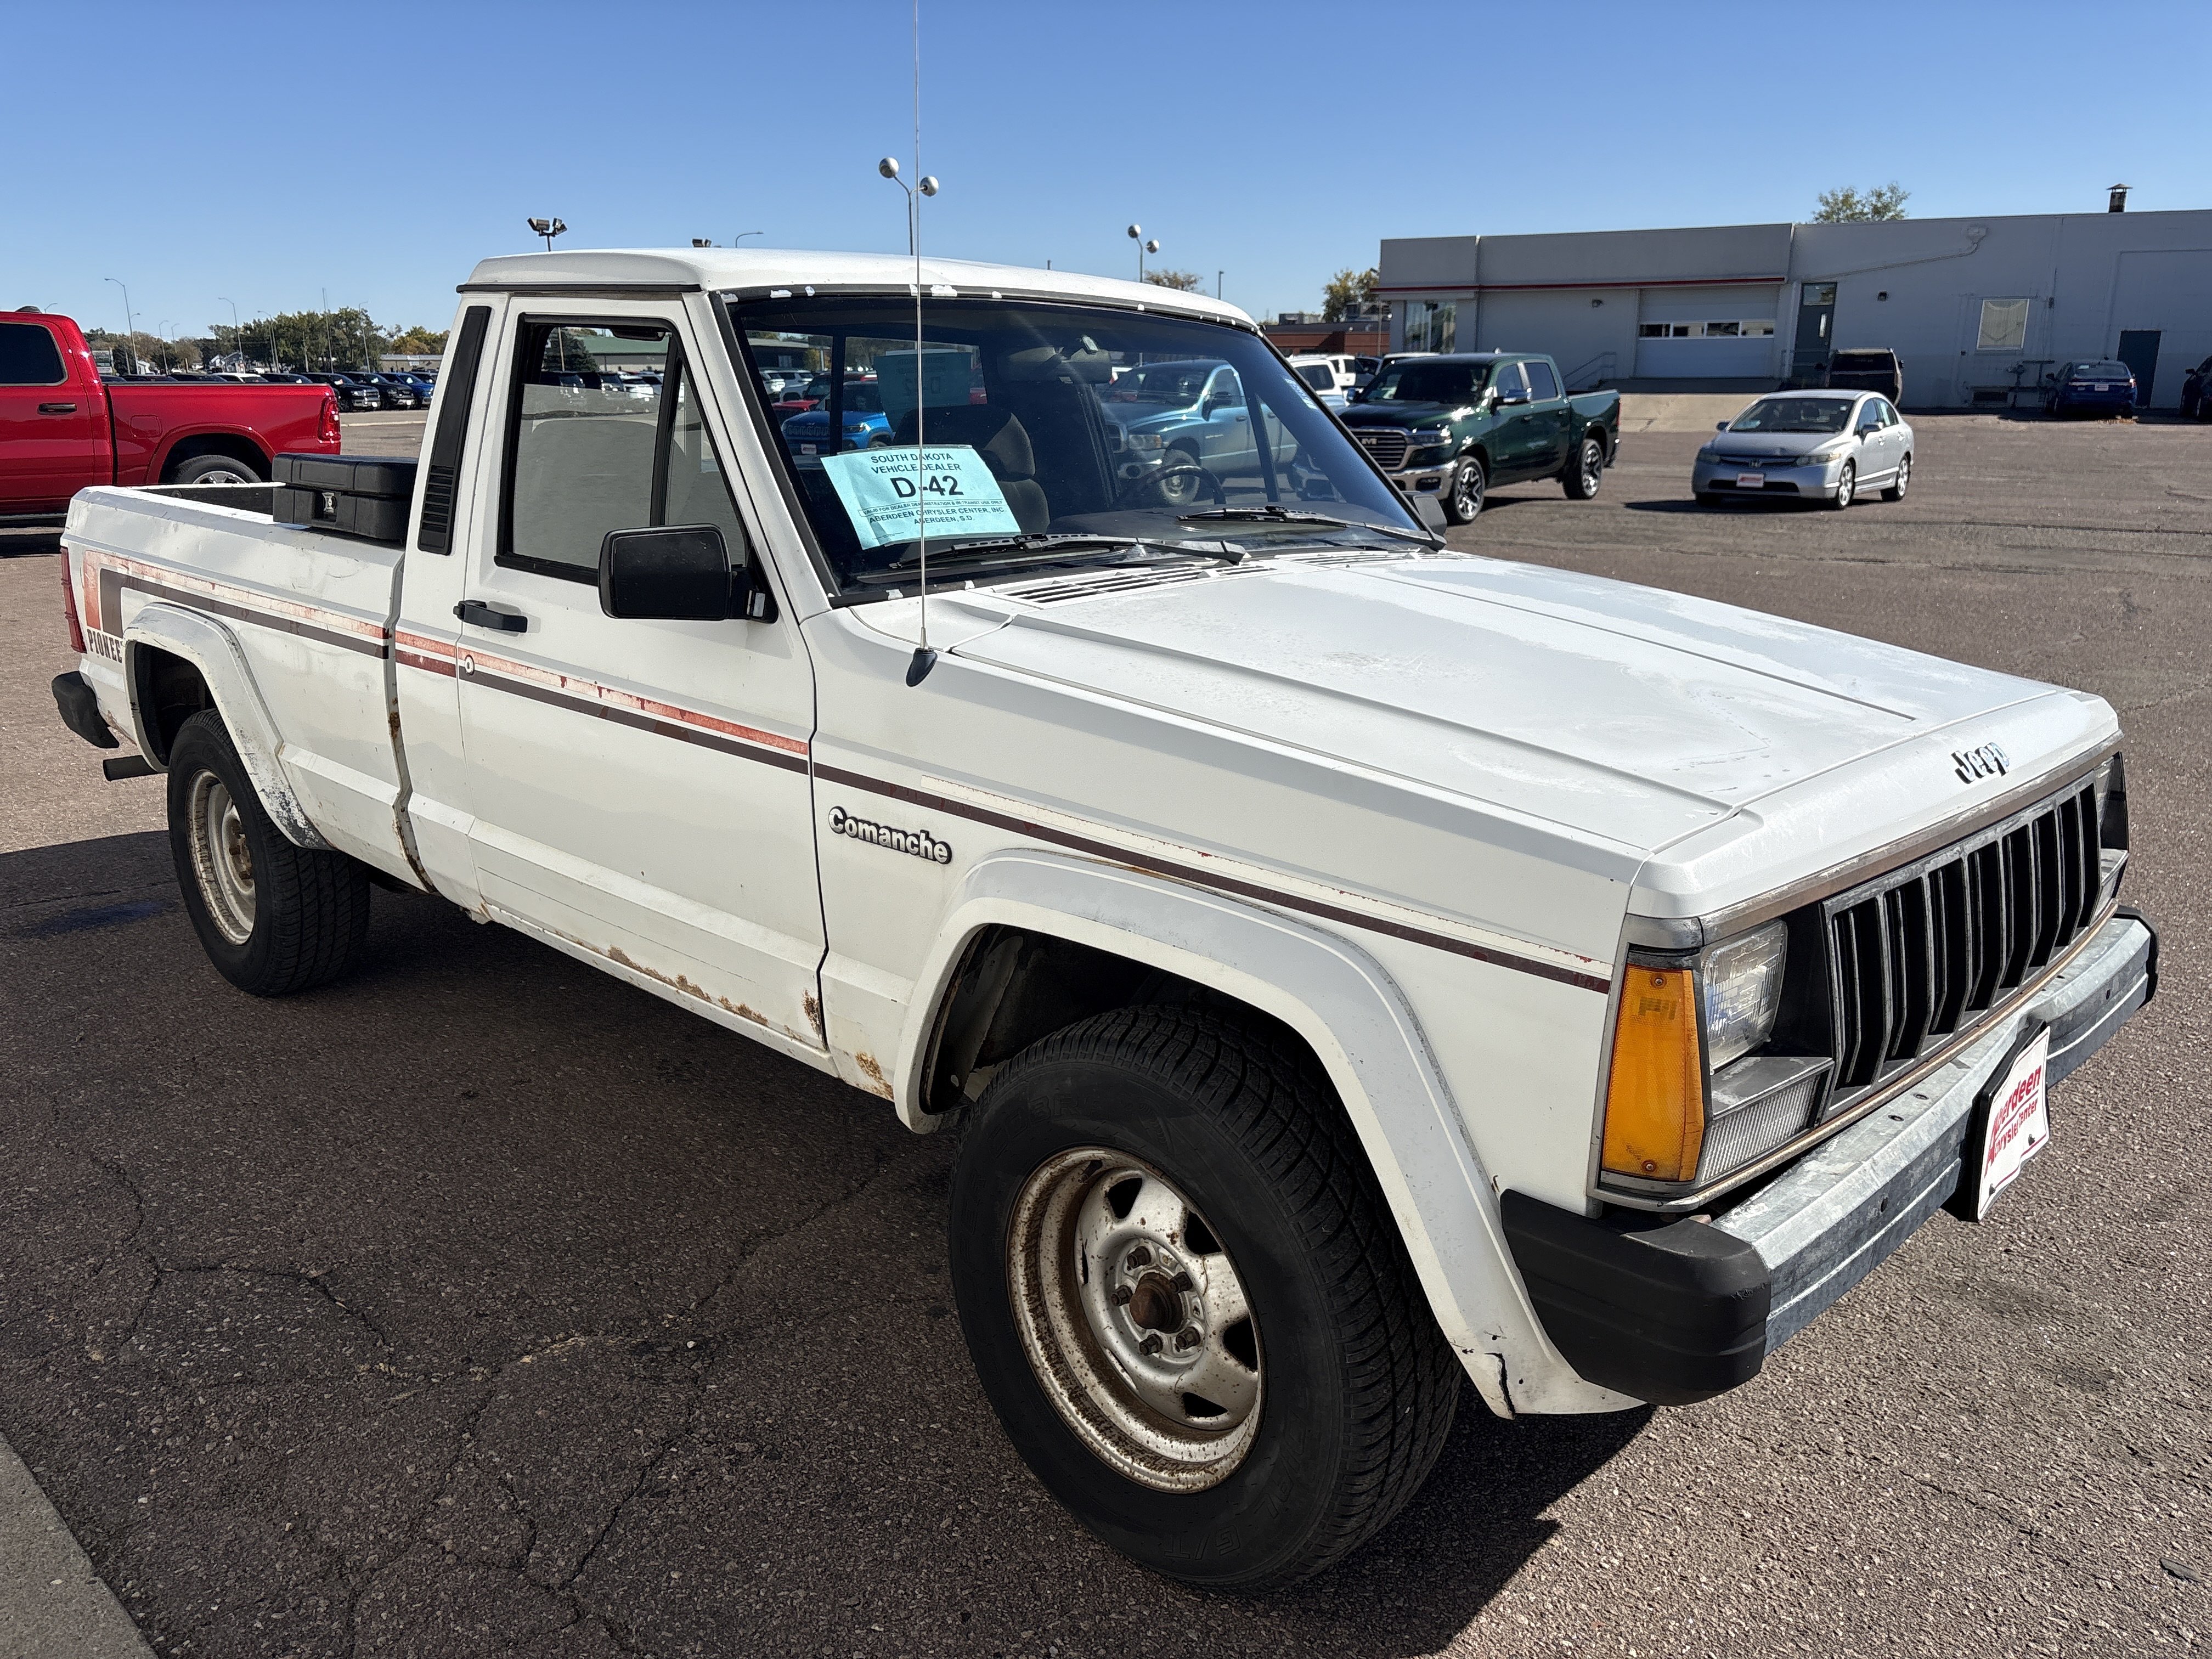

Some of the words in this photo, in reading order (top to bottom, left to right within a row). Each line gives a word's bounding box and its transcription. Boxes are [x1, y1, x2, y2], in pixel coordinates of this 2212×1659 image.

[871, 454, 909, 463] SOUTH
[871, 464, 919, 473] VEHICLE
[890, 476, 964, 498] D-42
[870, 511, 915, 523] ABERDEEN
[87, 628, 123, 664] PIONEE
[1951, 742, 2009, 785] Jeep
[828, 806, 952, 865] Comanche
